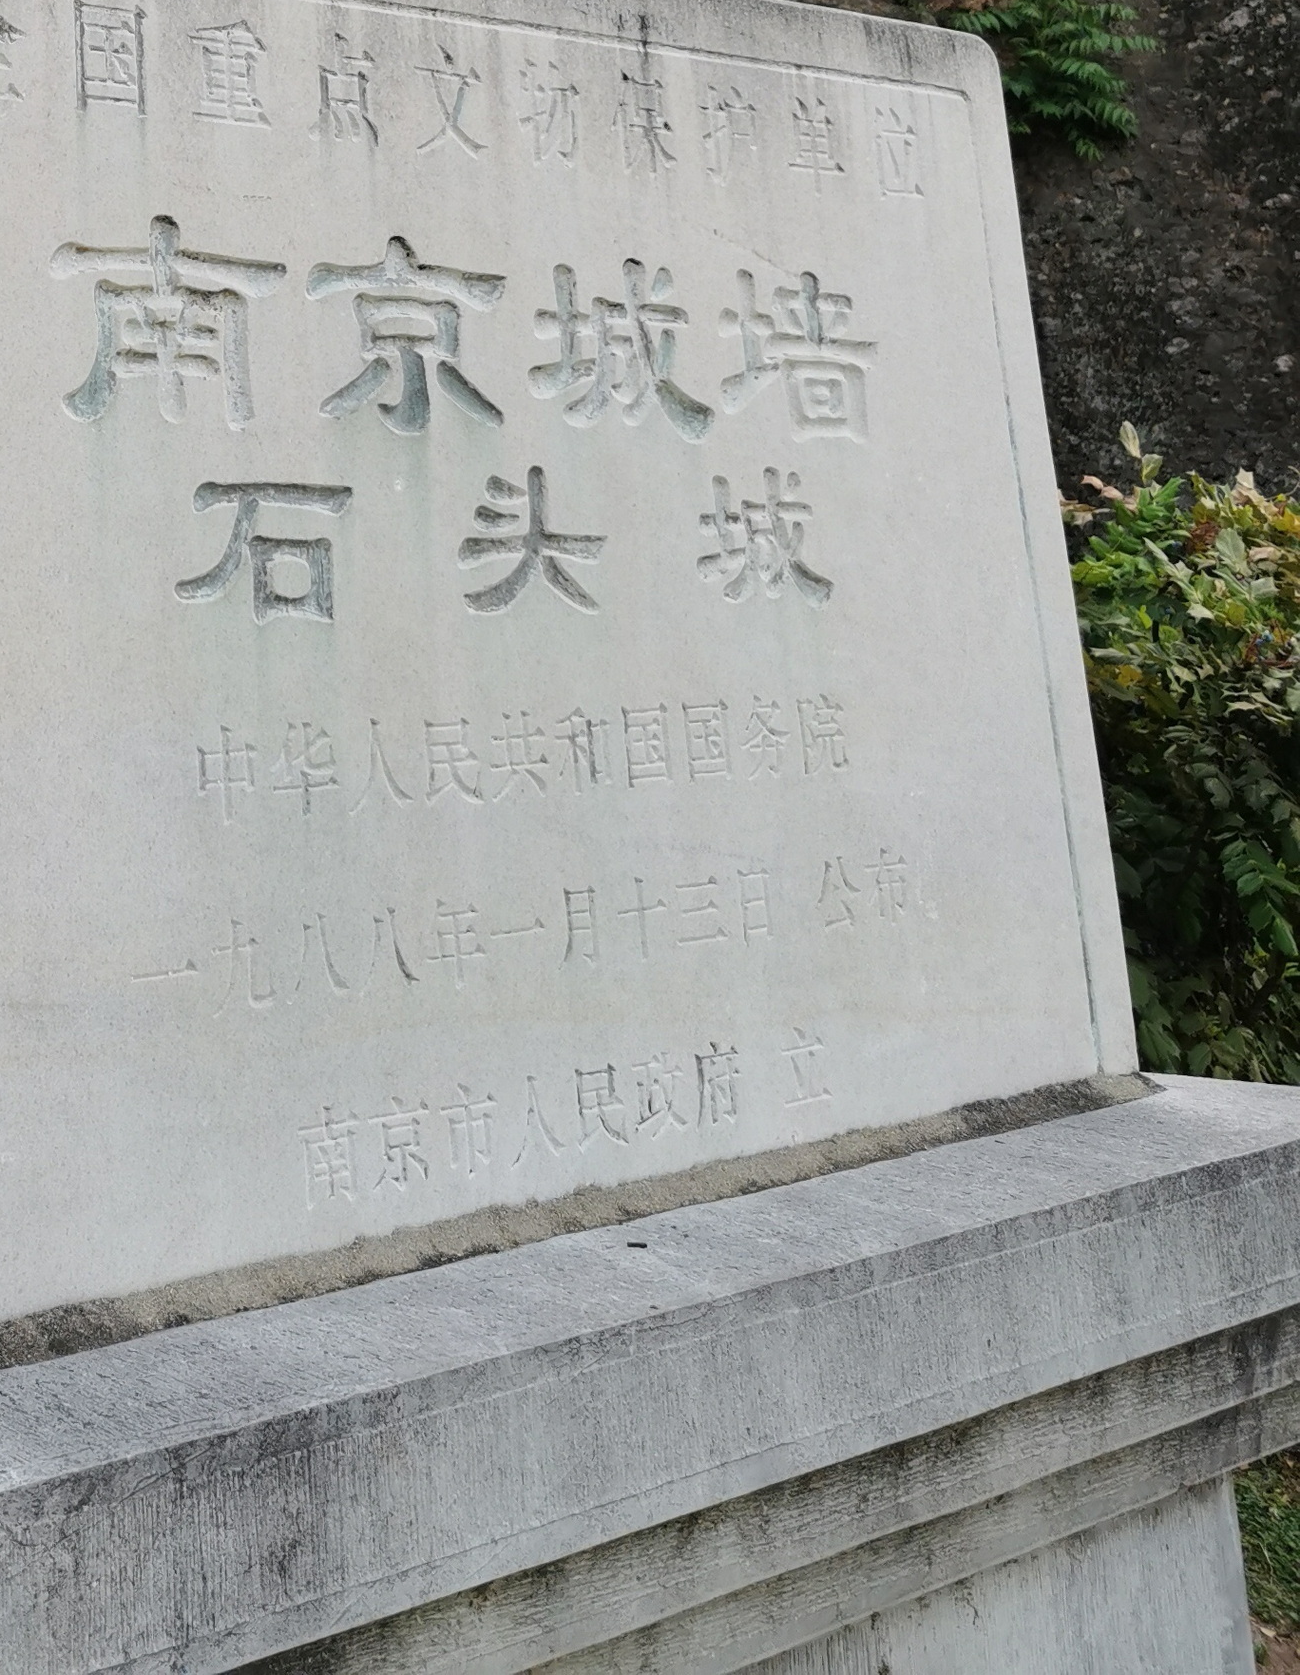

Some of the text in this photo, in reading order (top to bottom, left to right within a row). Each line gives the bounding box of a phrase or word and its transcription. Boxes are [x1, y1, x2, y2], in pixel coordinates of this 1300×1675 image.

[49, 214, 879, 444] 南京城墙
[173, 465, 835, 624] 石头城
[196, 694, 849, 825] 中华人民共和国国务院
[130, 847, 908, 1019] 一九八八年一月十三日 公布
[297, 1026, 834, 1209] 南京市人民政府 立
